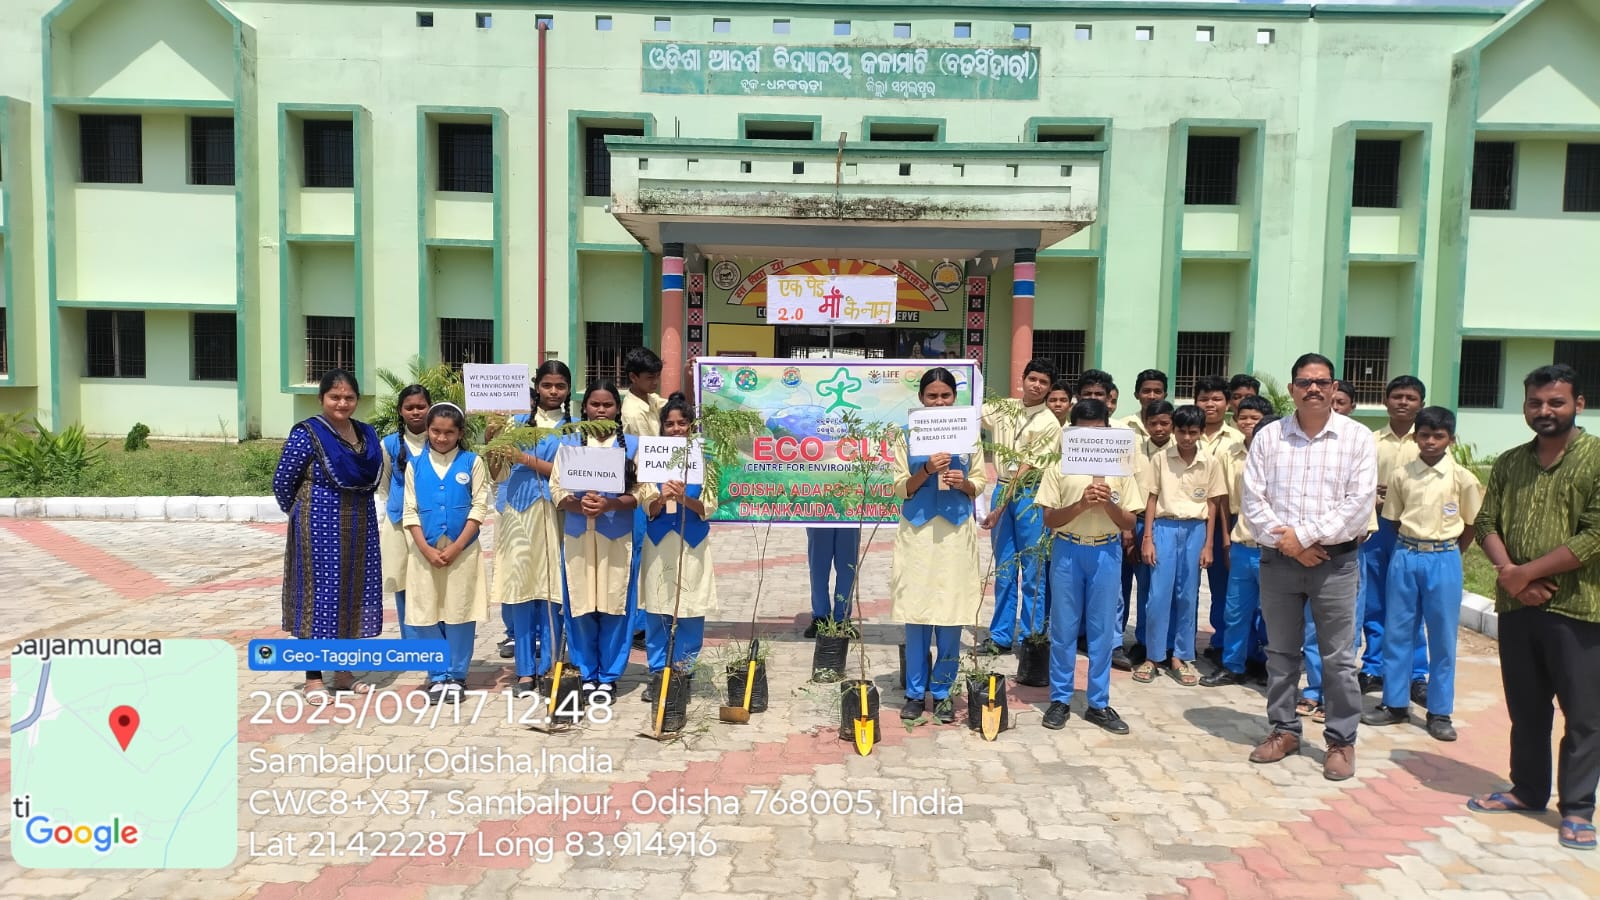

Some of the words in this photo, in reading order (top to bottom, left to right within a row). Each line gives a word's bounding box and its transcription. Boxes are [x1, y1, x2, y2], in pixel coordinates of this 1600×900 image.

[708, 46, 762, 72] ଆଦର୍ଶ
[778, 279, 802, 297] एक
[819, 286, 844, 318] माँ
[778, 307, 804, 320] 2.0
[644, 445, 669, 454] EACH
[754, 436, 824, 462] ECO
[645, 460, 672, 469] PLAN
[743, 463, 783, 473] (CENTRE
[786, 463, 805, 472] FOR
[567, 469, 593, 477] GREEN
[594, 470, 617, 479] INDIA
[729, 483, 786, 497] ODISHA
[739, 502, 840, 519] DHANKAUDA,
